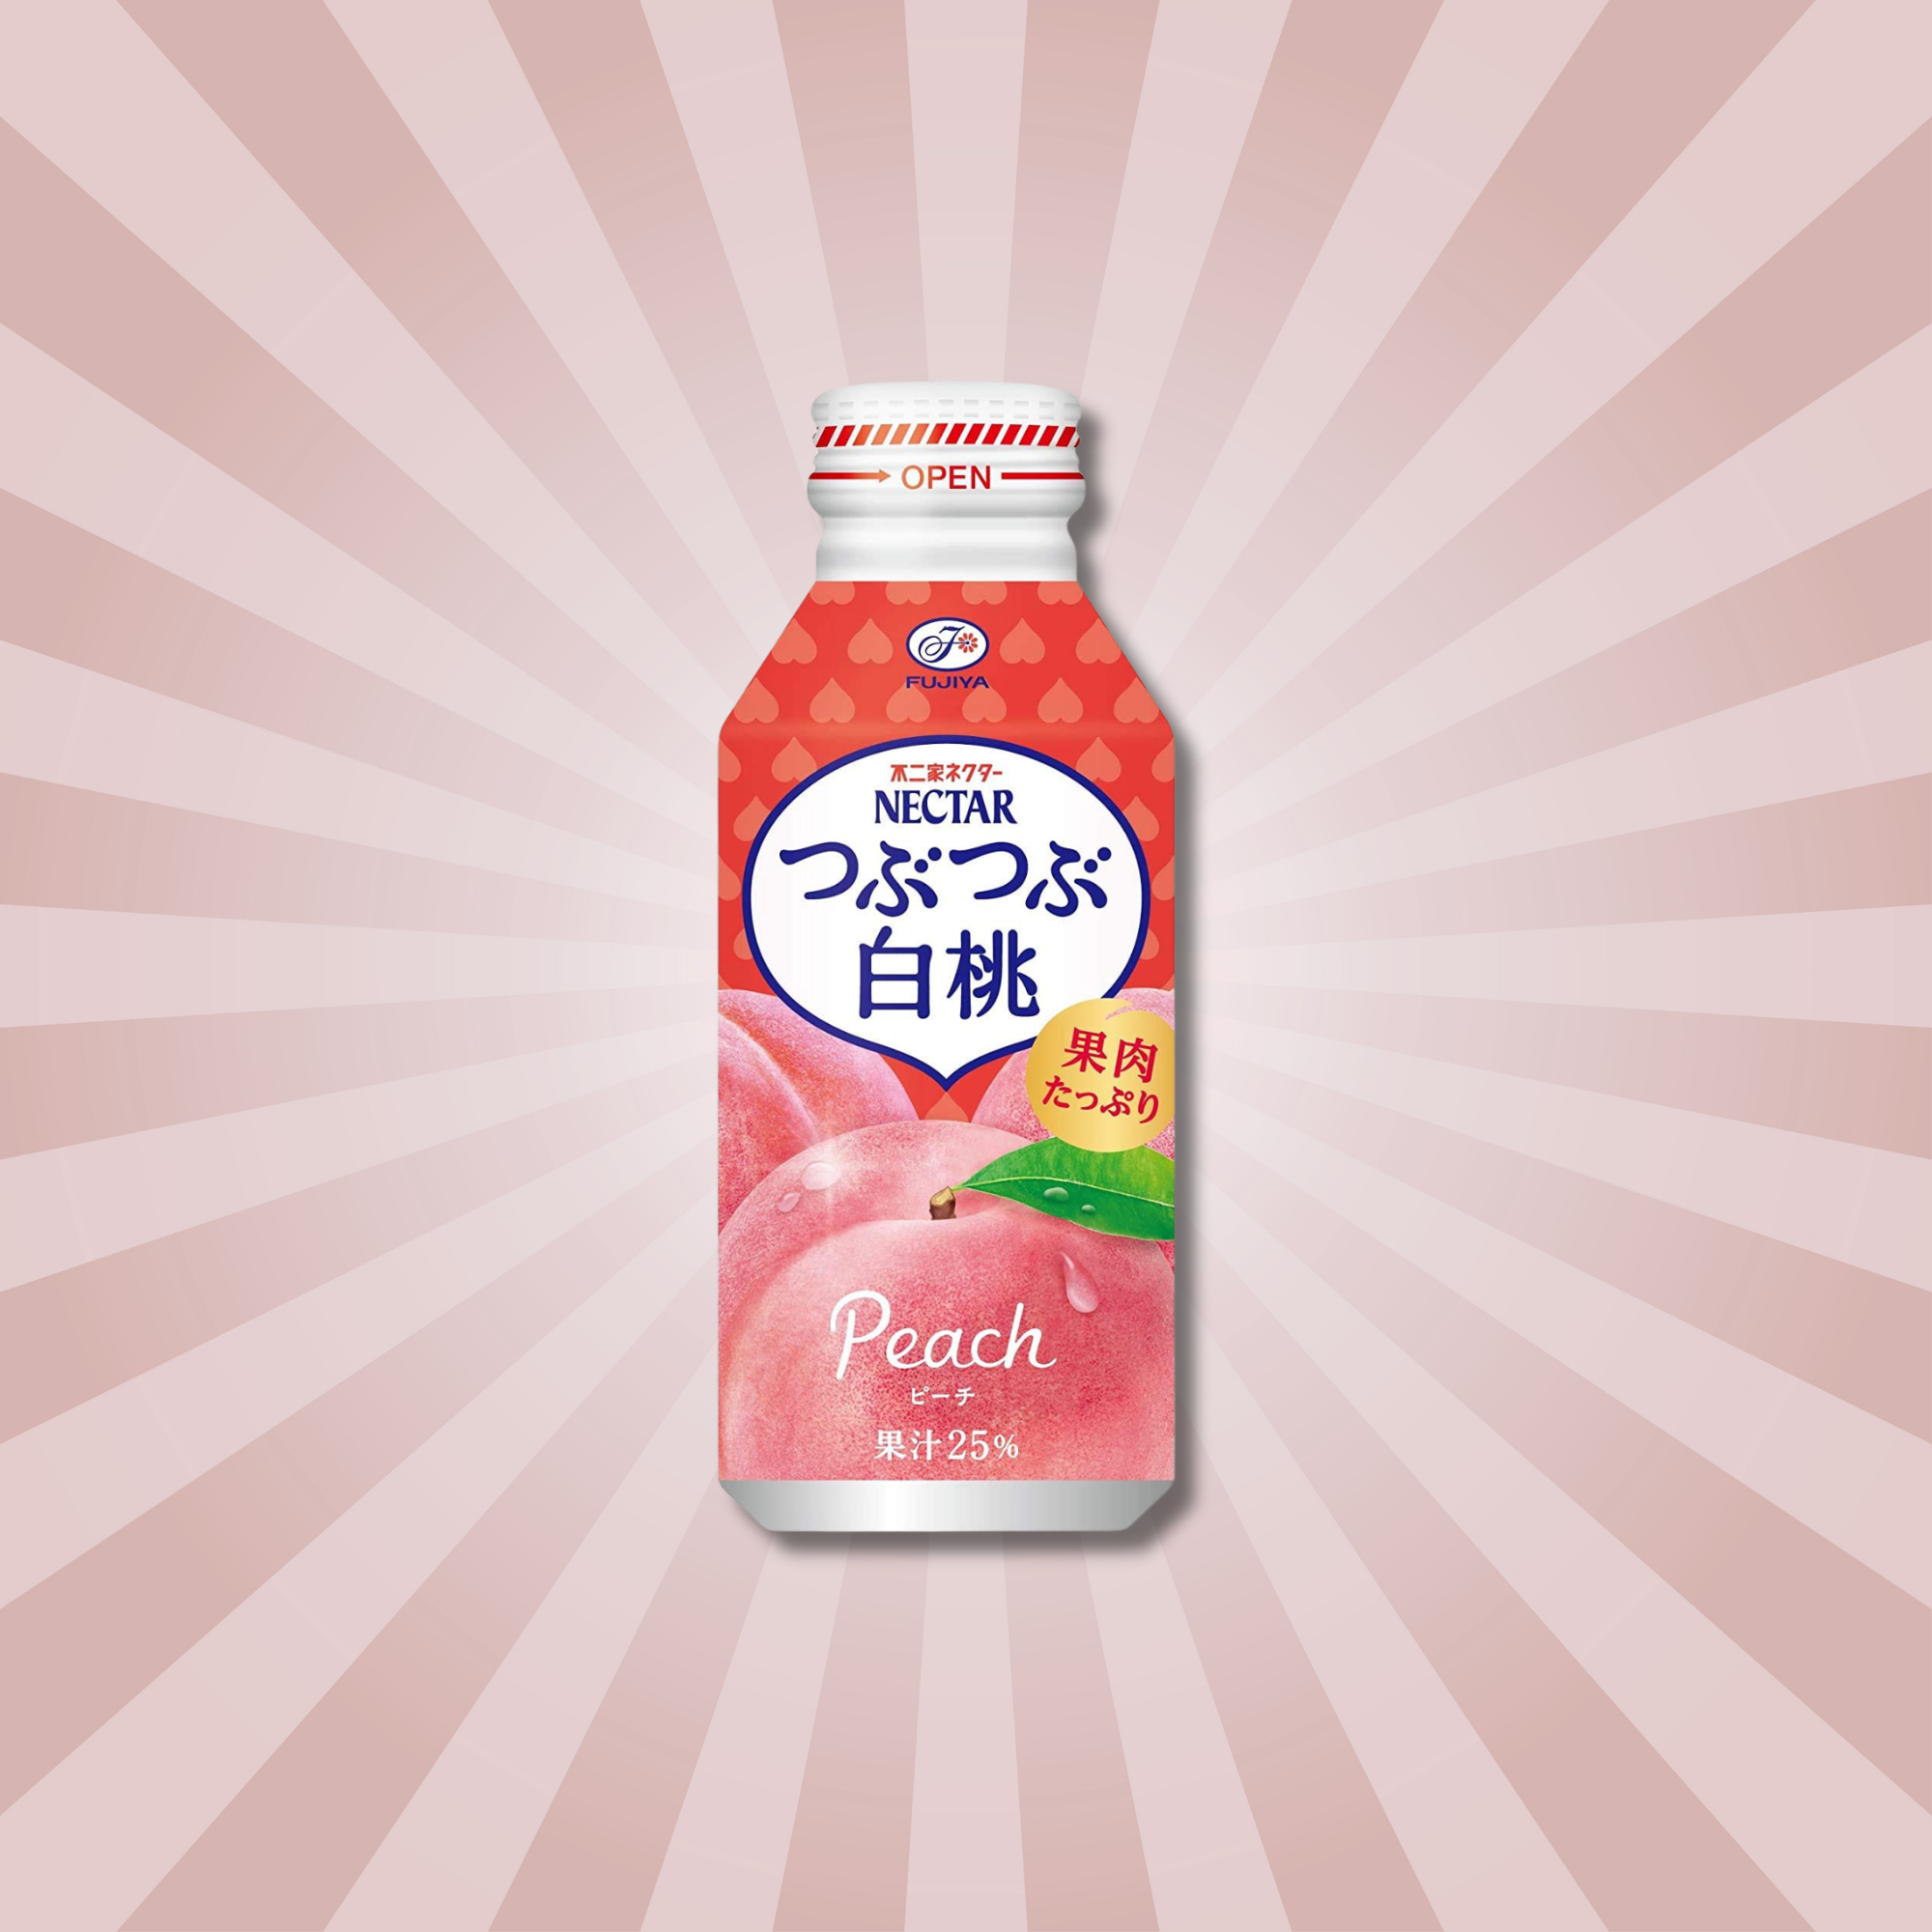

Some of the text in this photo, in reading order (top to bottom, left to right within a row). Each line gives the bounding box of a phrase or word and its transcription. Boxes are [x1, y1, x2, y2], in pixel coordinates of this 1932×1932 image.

[901, 465, 991, 490] OPEN
[906, 675, 990, 689] FUJIYA
[891, 763, 1003, 782] 不二家ネクター
[874, 788, 1018, 825] NECTAR
[779, 840, 1113, 918] つぶつぶ
[858, 925, 1040, 1021] 白桃
[1061, 1027, 1159, 1084] 果肉
[1041, 1074, 1160, 1124] たっぷり
[830, 1290, 1058, 1379] Peach
[910, 1385, 977, 1406] ピーチ
